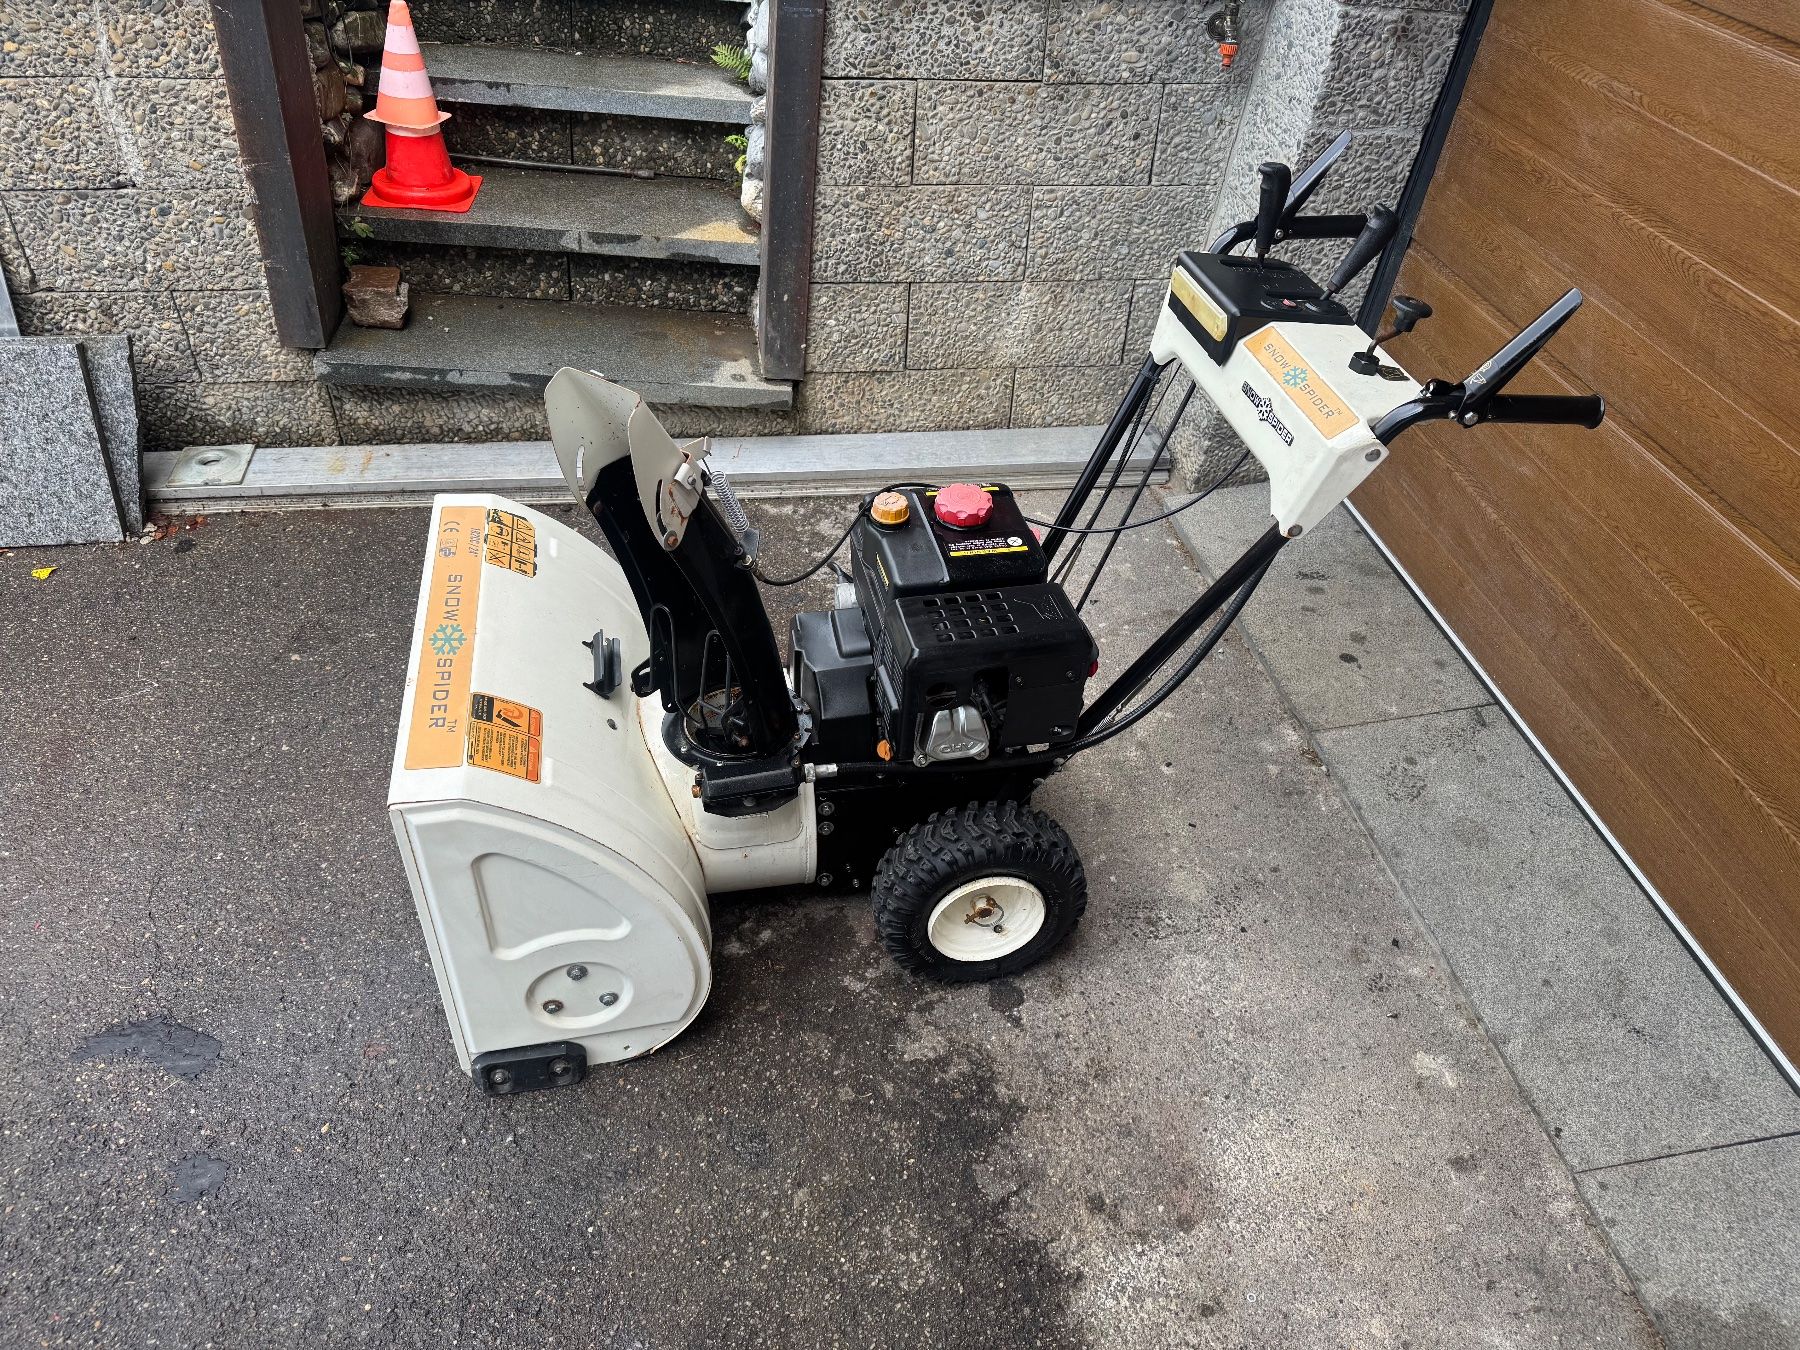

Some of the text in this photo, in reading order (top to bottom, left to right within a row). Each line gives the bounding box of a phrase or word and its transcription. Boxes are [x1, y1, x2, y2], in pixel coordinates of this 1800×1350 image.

[1242, 381, 1293, 444] SNOW SPIDER
[1263, 343, 1291, 369] SNOW
[1300, 383, 1334, 419] SPIDER
[442, 574, 463, 621] SNOW
[428, 658, 453, 729] SPIDER
